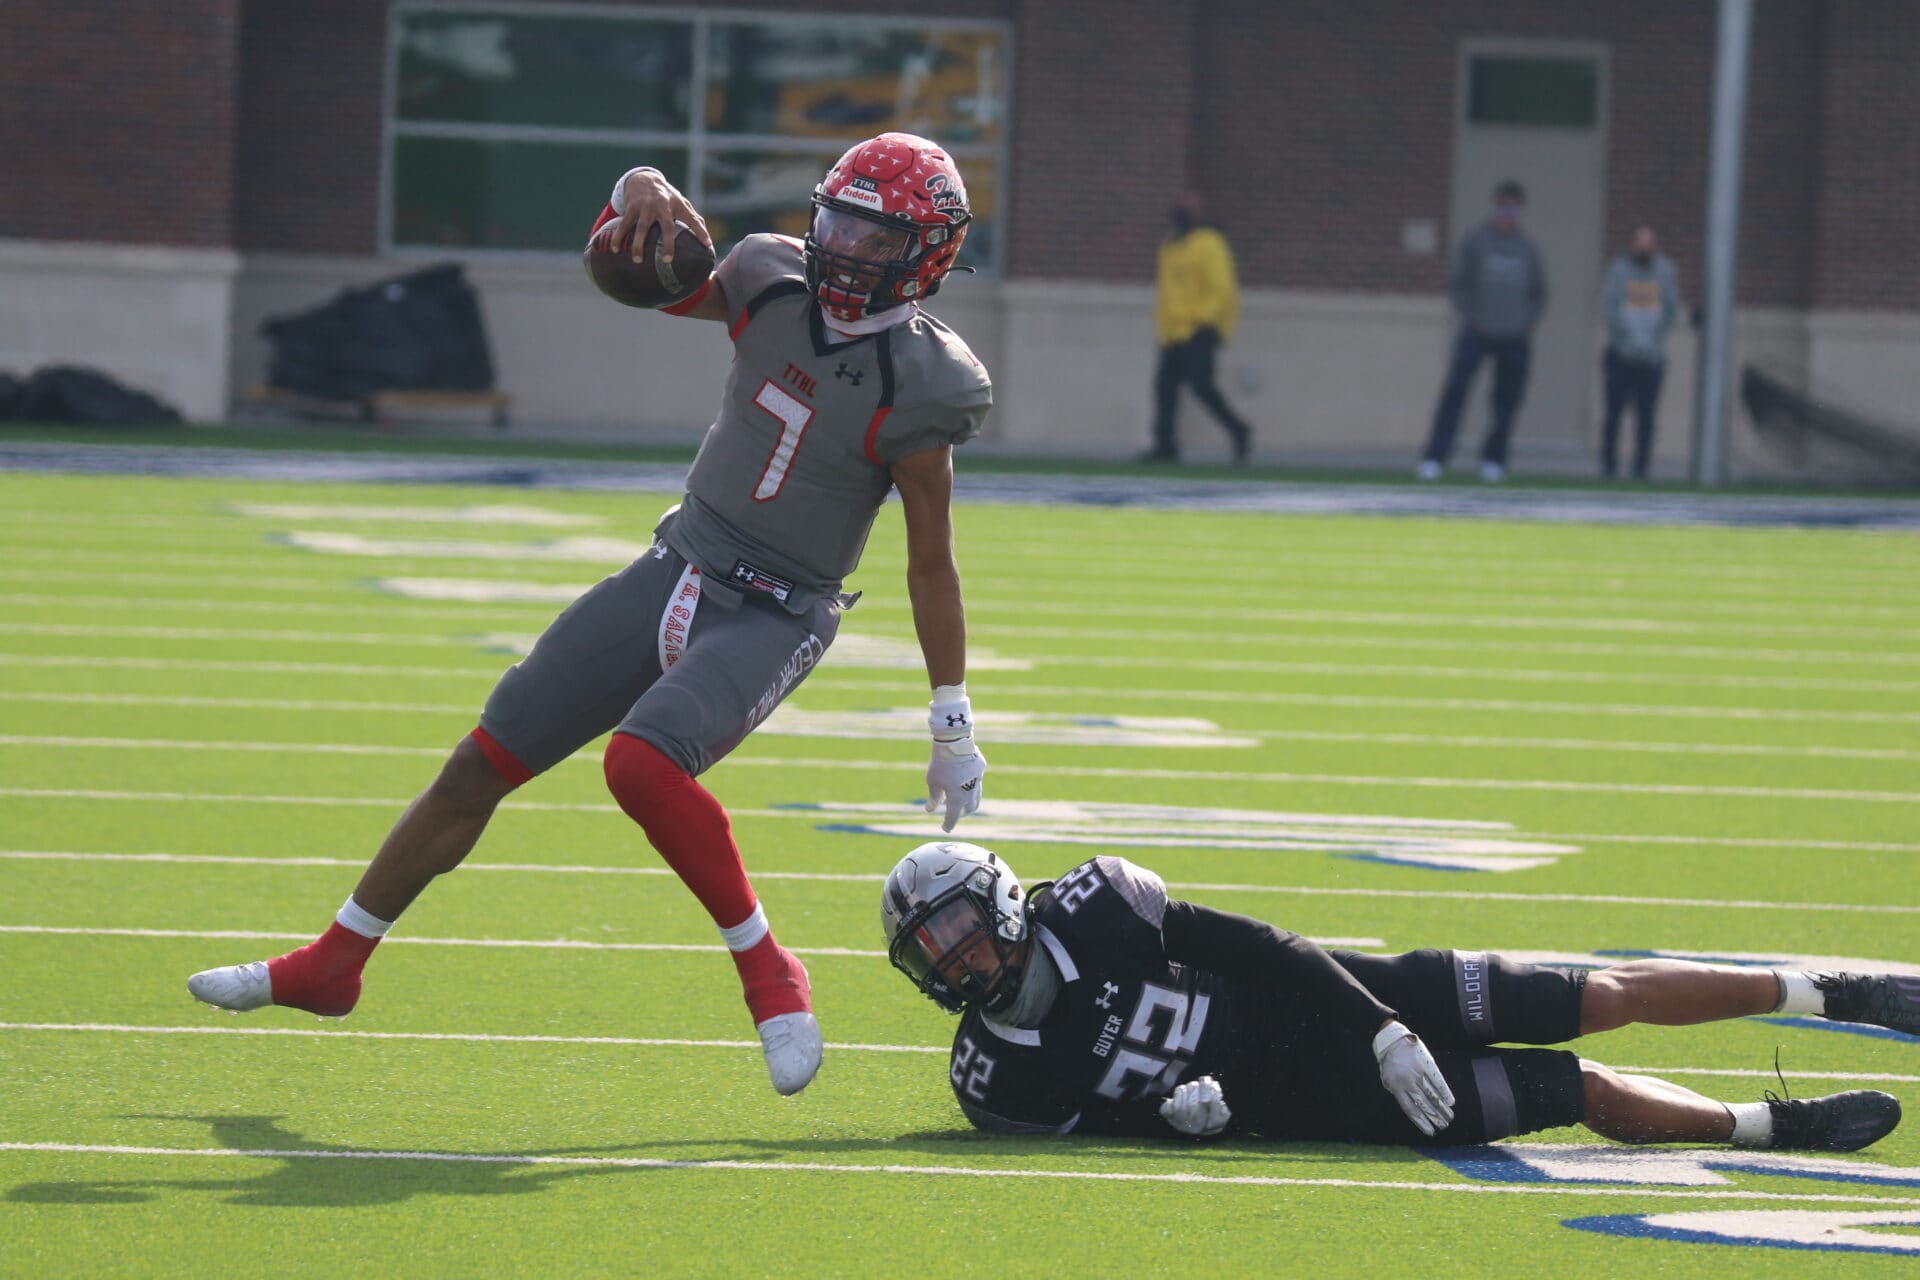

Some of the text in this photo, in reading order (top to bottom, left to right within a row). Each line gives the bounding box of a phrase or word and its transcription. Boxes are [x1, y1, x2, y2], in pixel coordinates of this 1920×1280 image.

[842, 187, 878, 204] Riddell
[783, 362, 817, 398] TTHL
[749, 376, 816, 504] 7
[678, 582, 699, 602] K.
[1052, 861, 1101, 916] 22
[1092, 1015, 1124, 1058] GUYER
[1096, 981, 1211, 1101] 22
[950, 1036, 995, 1101] 22
